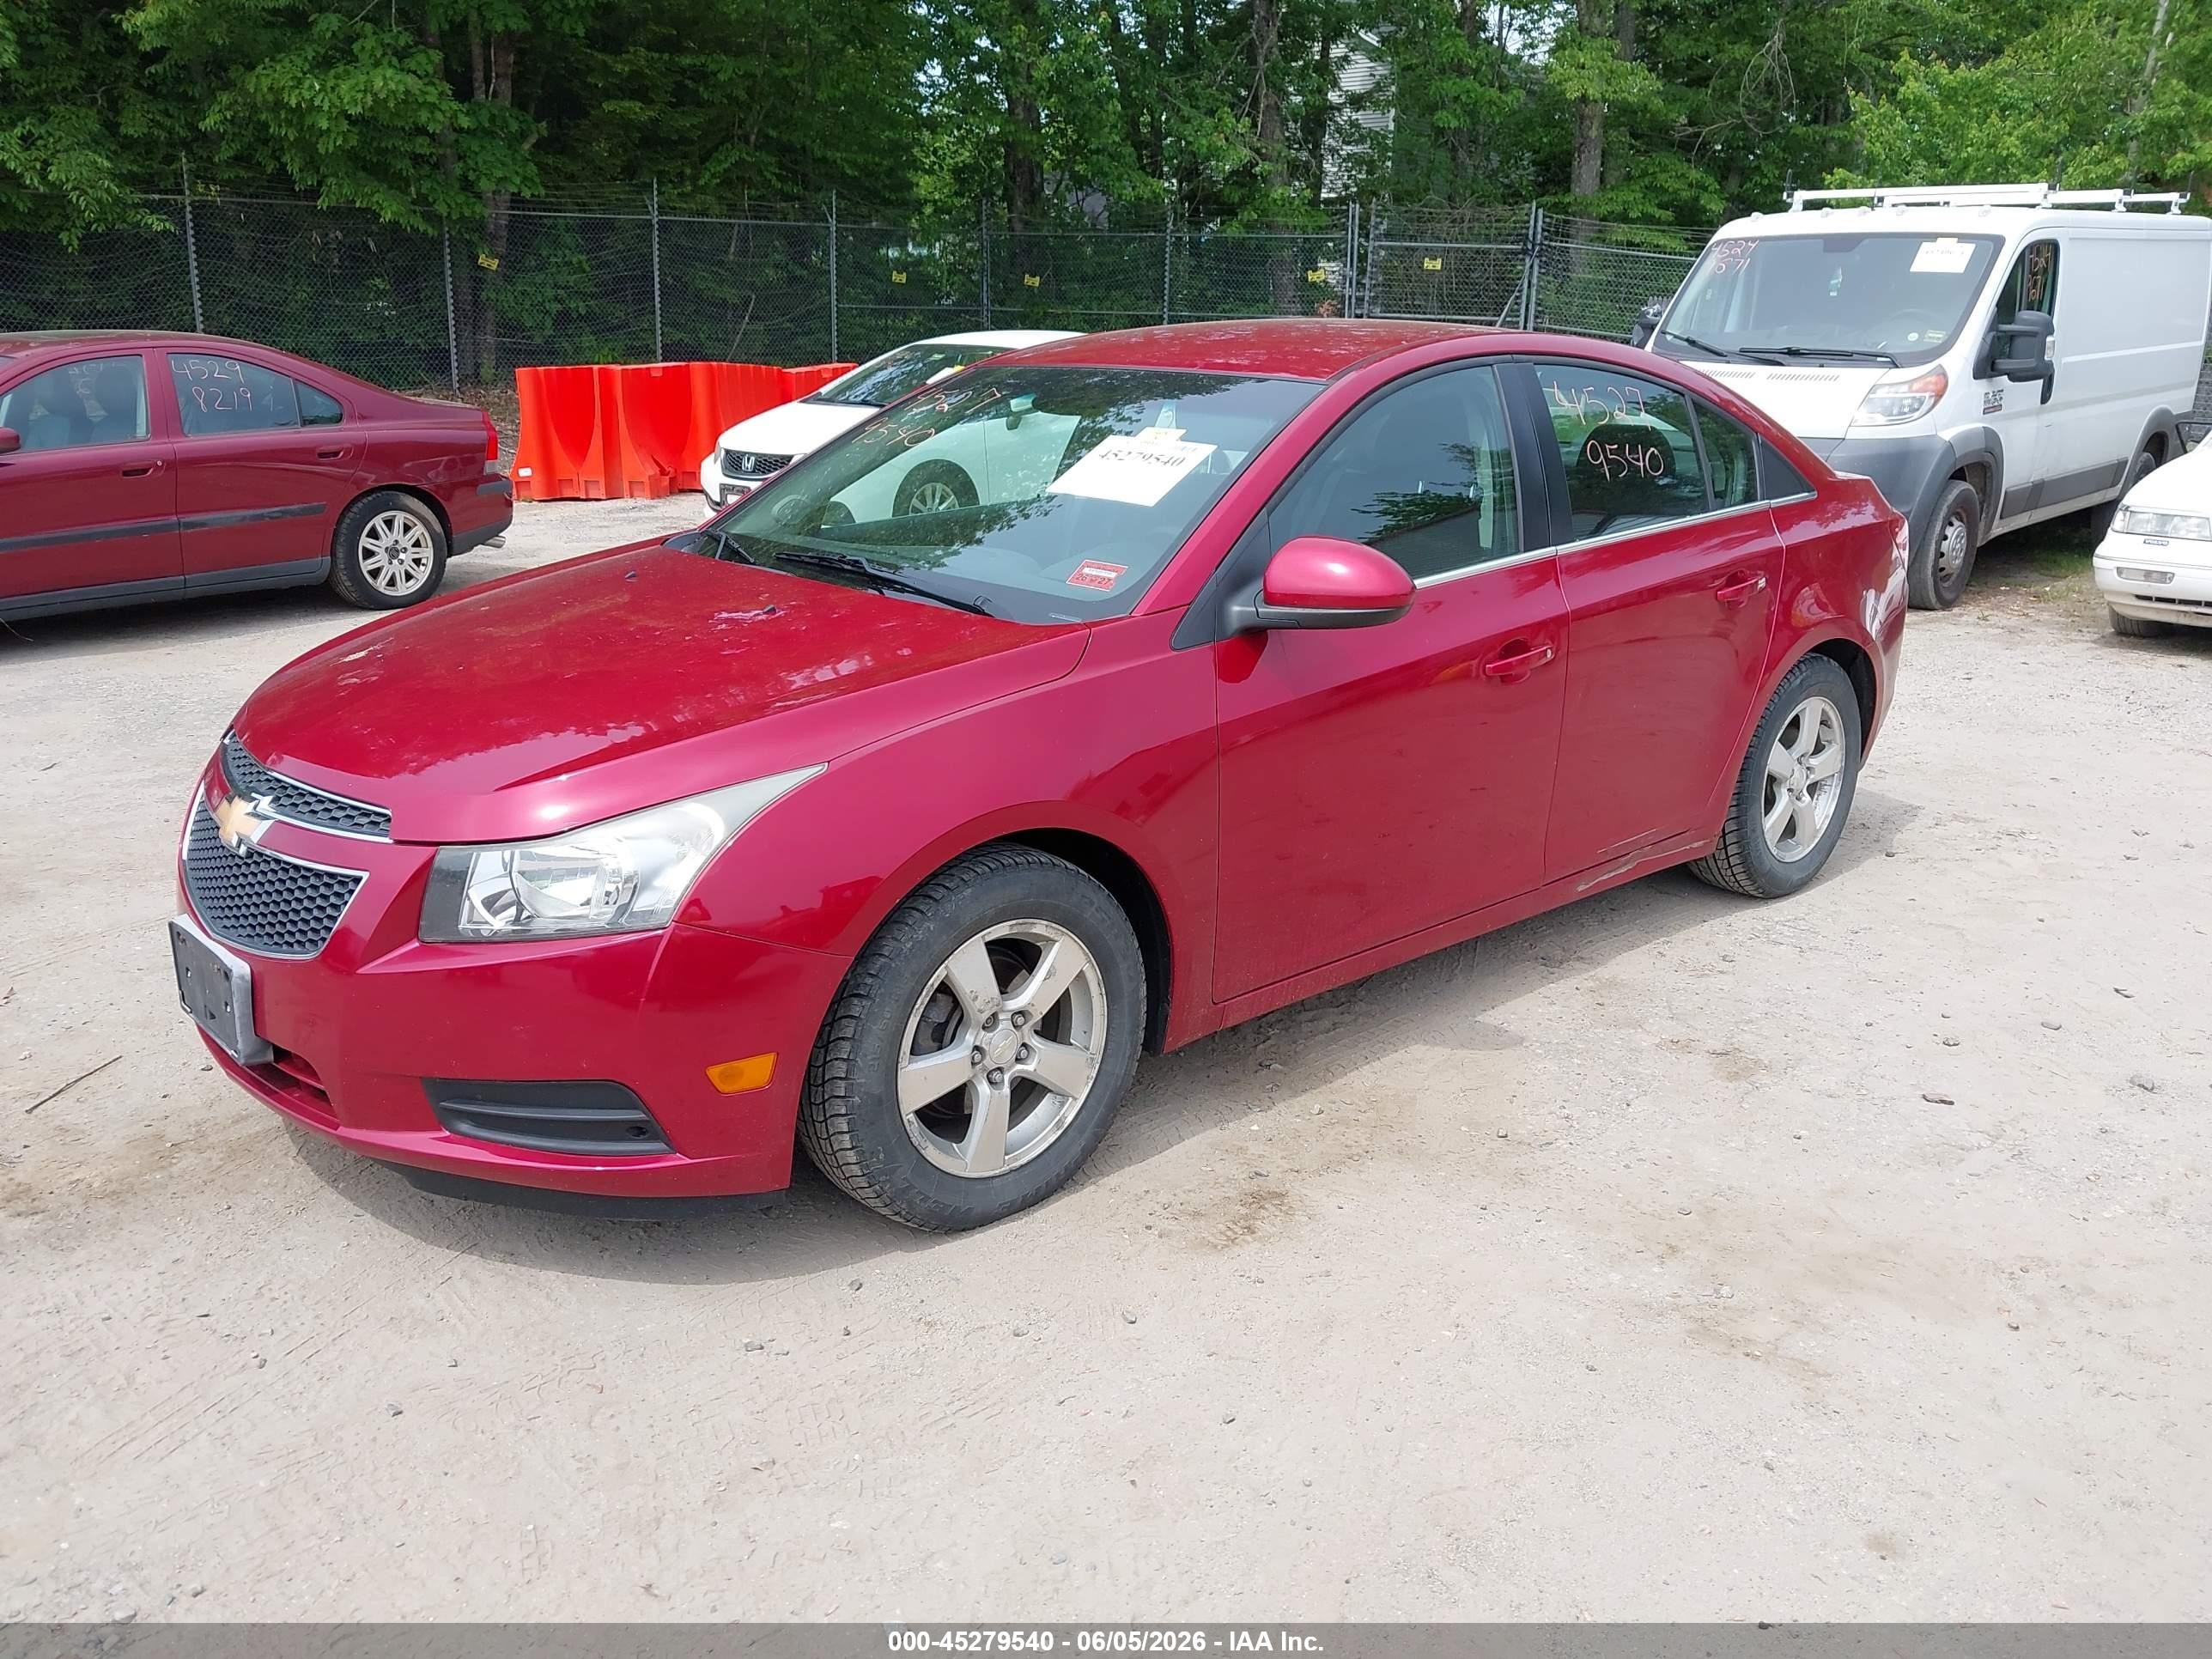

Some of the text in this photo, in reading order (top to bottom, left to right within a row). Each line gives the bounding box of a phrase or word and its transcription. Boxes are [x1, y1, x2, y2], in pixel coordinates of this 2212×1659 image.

[172, 360, 245, 385] 4529
[191, 386, 252, 412] 8219
[1553, 380, 1651, 431] 4527
[1587, 440, 1664, 483] 9540
